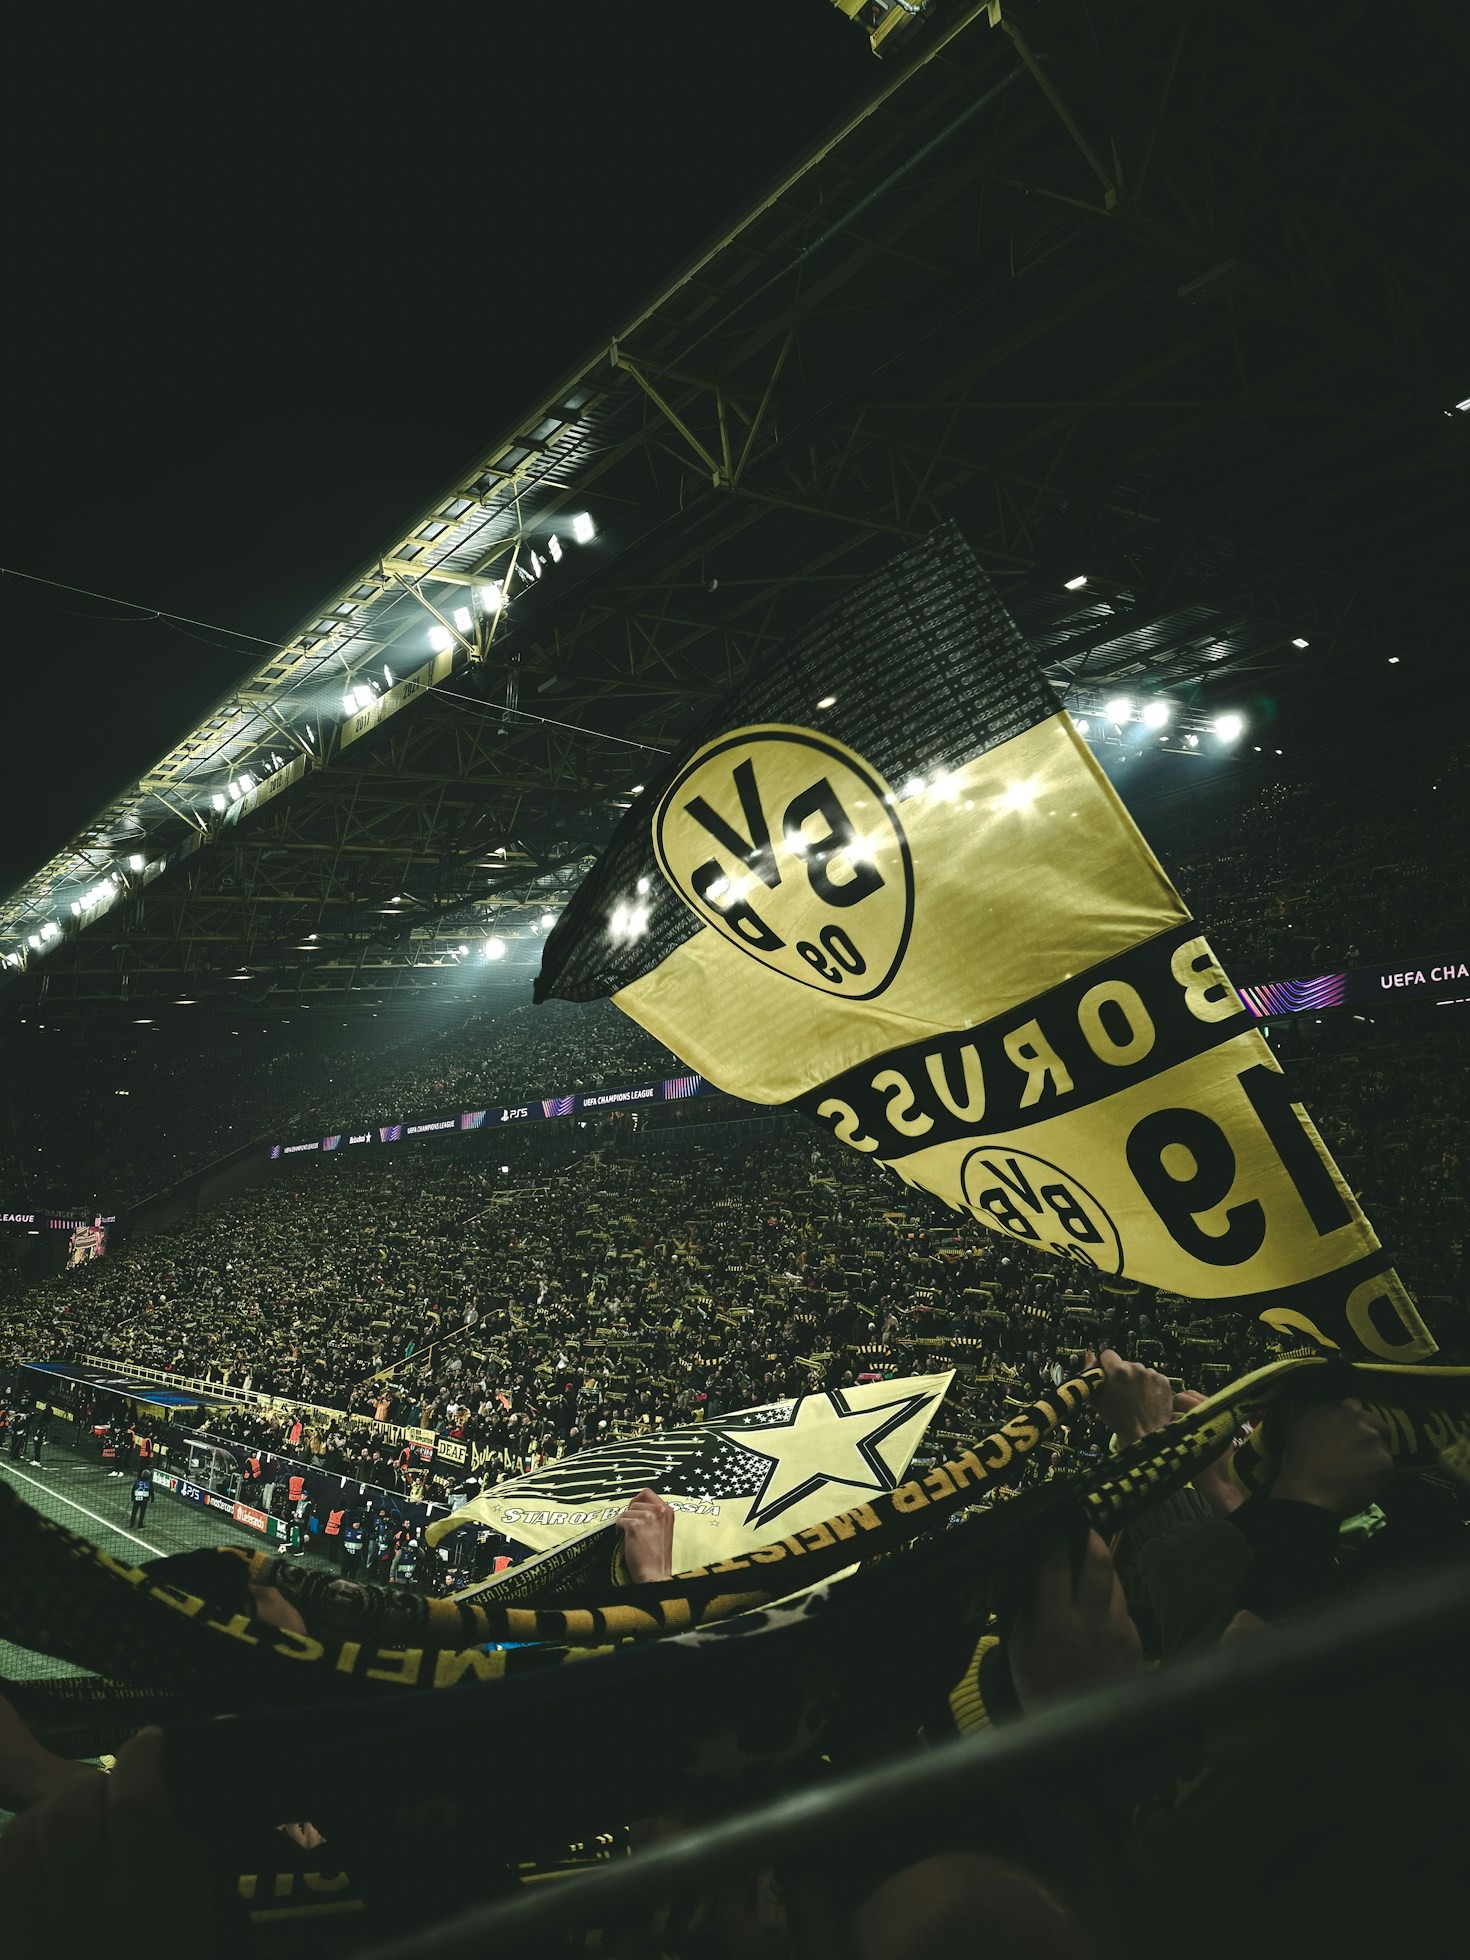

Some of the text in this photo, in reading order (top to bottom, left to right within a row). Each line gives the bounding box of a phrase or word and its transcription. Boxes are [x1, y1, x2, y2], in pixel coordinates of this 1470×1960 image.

[355, 711, 371, 733] 2017
[1380, 970, 1427, 990] UEFA
[583, 1088, 654, 1107] UEFA CHAMPIONS LEAGUE
[509, 1107, 528, 1119] PS5
[438, 1442, 466, 1460] DEAF
[186, 1485, 200, 1501] PS5
[501, 1507, 568, 1526] STAR
[567, 1509, 605, 1525] OF
